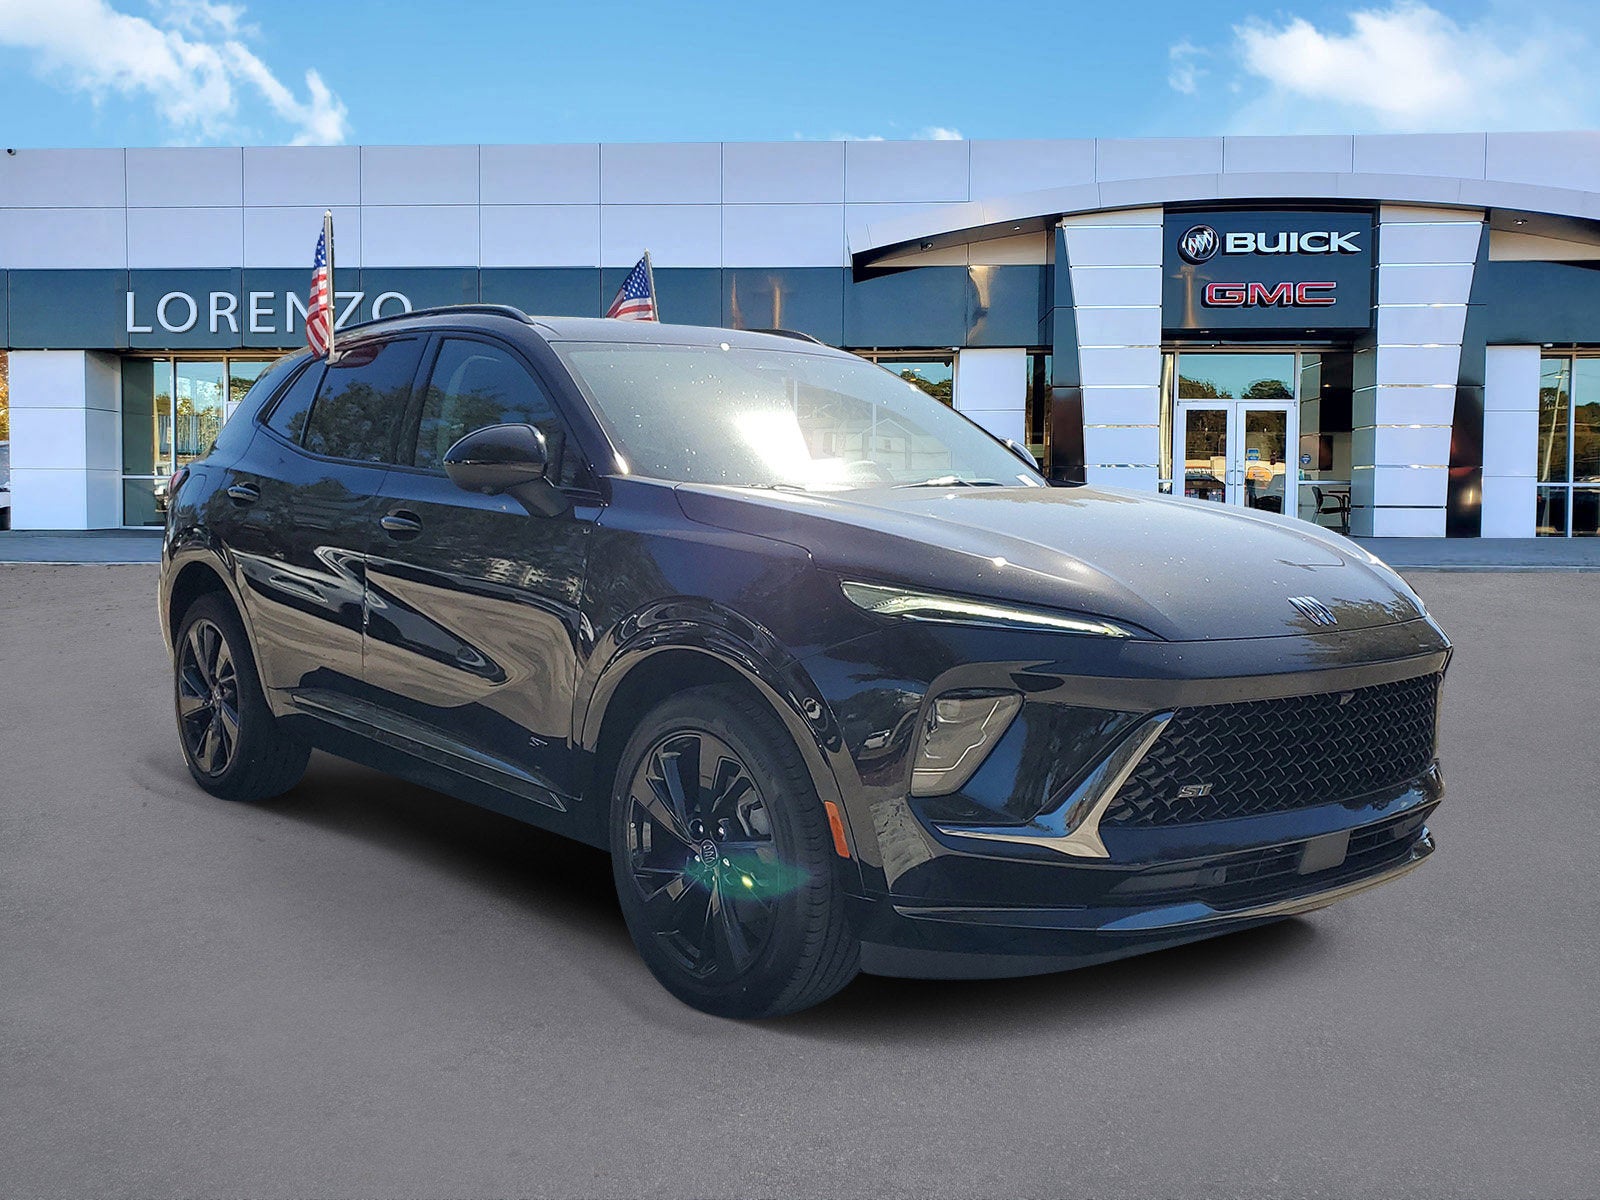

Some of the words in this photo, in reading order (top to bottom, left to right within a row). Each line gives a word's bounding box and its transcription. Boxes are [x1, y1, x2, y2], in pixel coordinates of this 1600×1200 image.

[1226, 231, 1361, 252] BUICK
[1207, 282, 1336, 305] GMC
[126, 291, 412, 333] LORENZO
